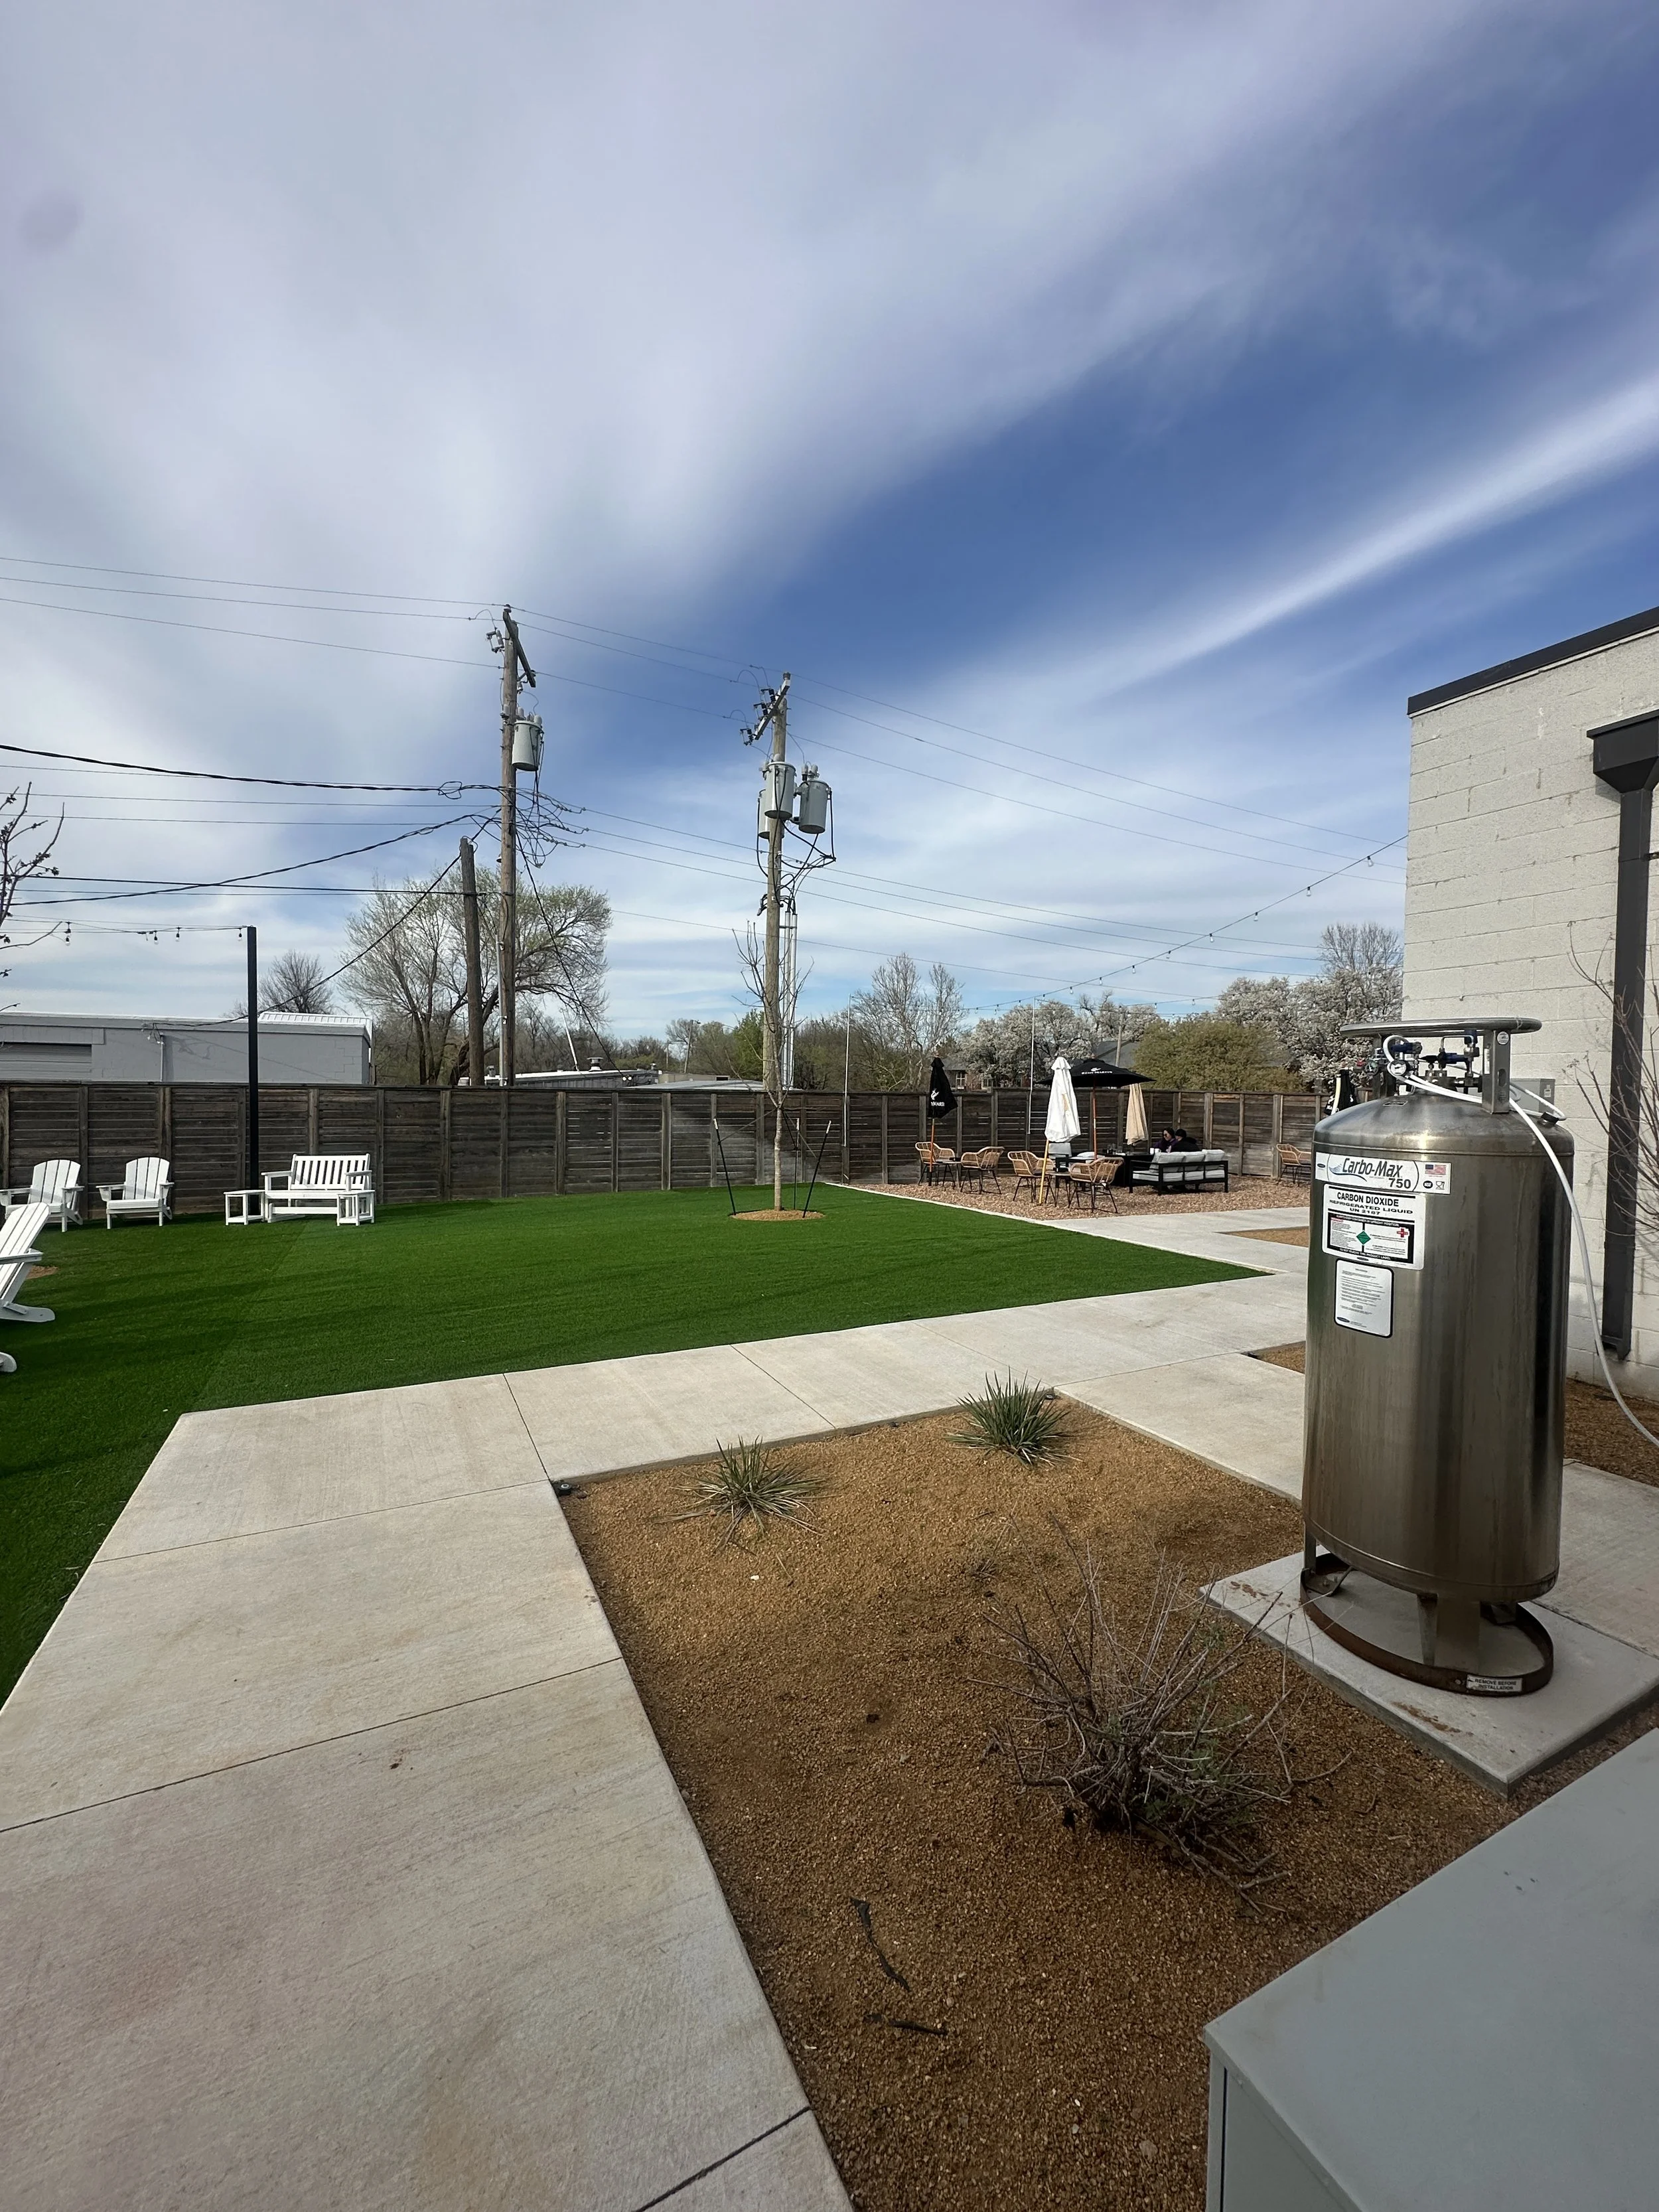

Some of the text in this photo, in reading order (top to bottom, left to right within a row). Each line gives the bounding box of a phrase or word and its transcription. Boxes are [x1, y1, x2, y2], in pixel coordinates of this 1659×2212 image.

[1342, 1158, 1403, 1178] Carbo-Max
[1388, 1177, 1411, 1189] 750
[1329, 1200, 1380, 1211] REFRIGERATED
[1337, 1192, 1399, 1207] CARBON DIOXIDE
